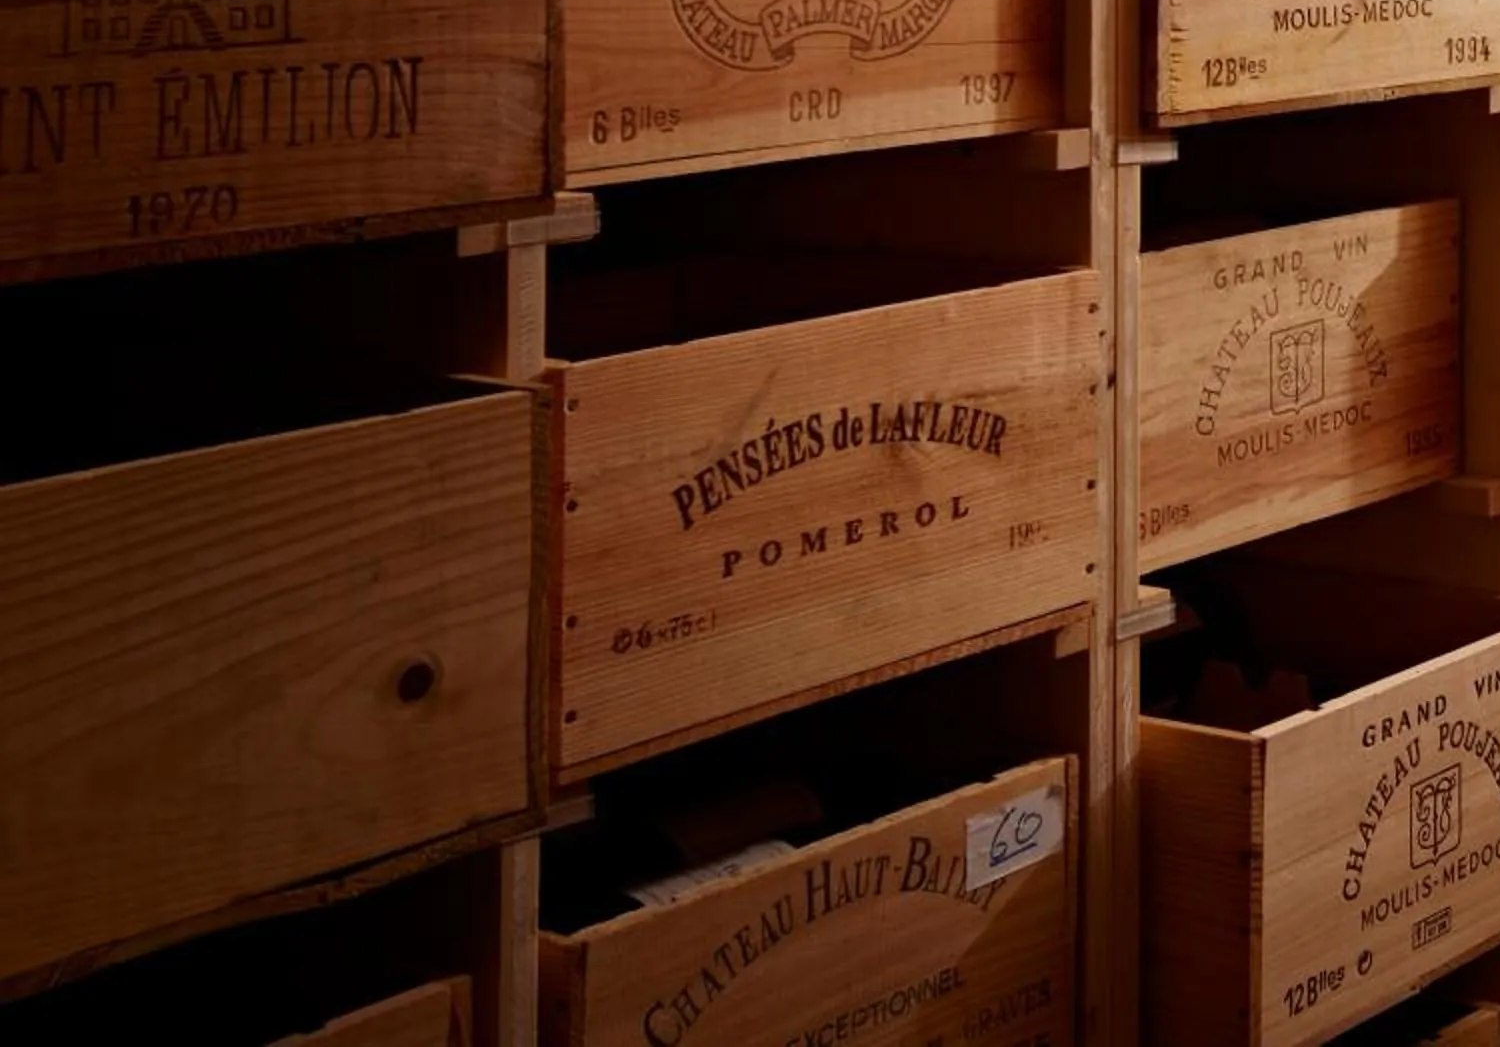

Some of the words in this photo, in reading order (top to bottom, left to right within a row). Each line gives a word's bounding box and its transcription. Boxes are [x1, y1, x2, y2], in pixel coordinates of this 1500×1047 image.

[1444, 36, 1492, 65] 1994
[788, 88, 843, 123] CRD
[959, 70, 1017, 105] 1997
[126, 184, 239, 237] 1970
[1213, 249, 1304, 291] GRAND
[1332, 234, 1369, 261] VIN
[1195, 287, 1280, 438] CHATEAU
[1296, 275, 1389, 388] POUJEAUX
[671, 411, 825, 533] PENSÉES
[831, 407, 864, 452] de
[867, 399, 1008, 458] LAFLEUR
[720, 494, 971, 580] POMEROL
[1361, 693, 1449, 749] GRAND
[988, 807, 1044, 868] 60
[1342, 737, 1422, 903] CHATEAU
[641, 894, 796, 1047] CHATEAU
